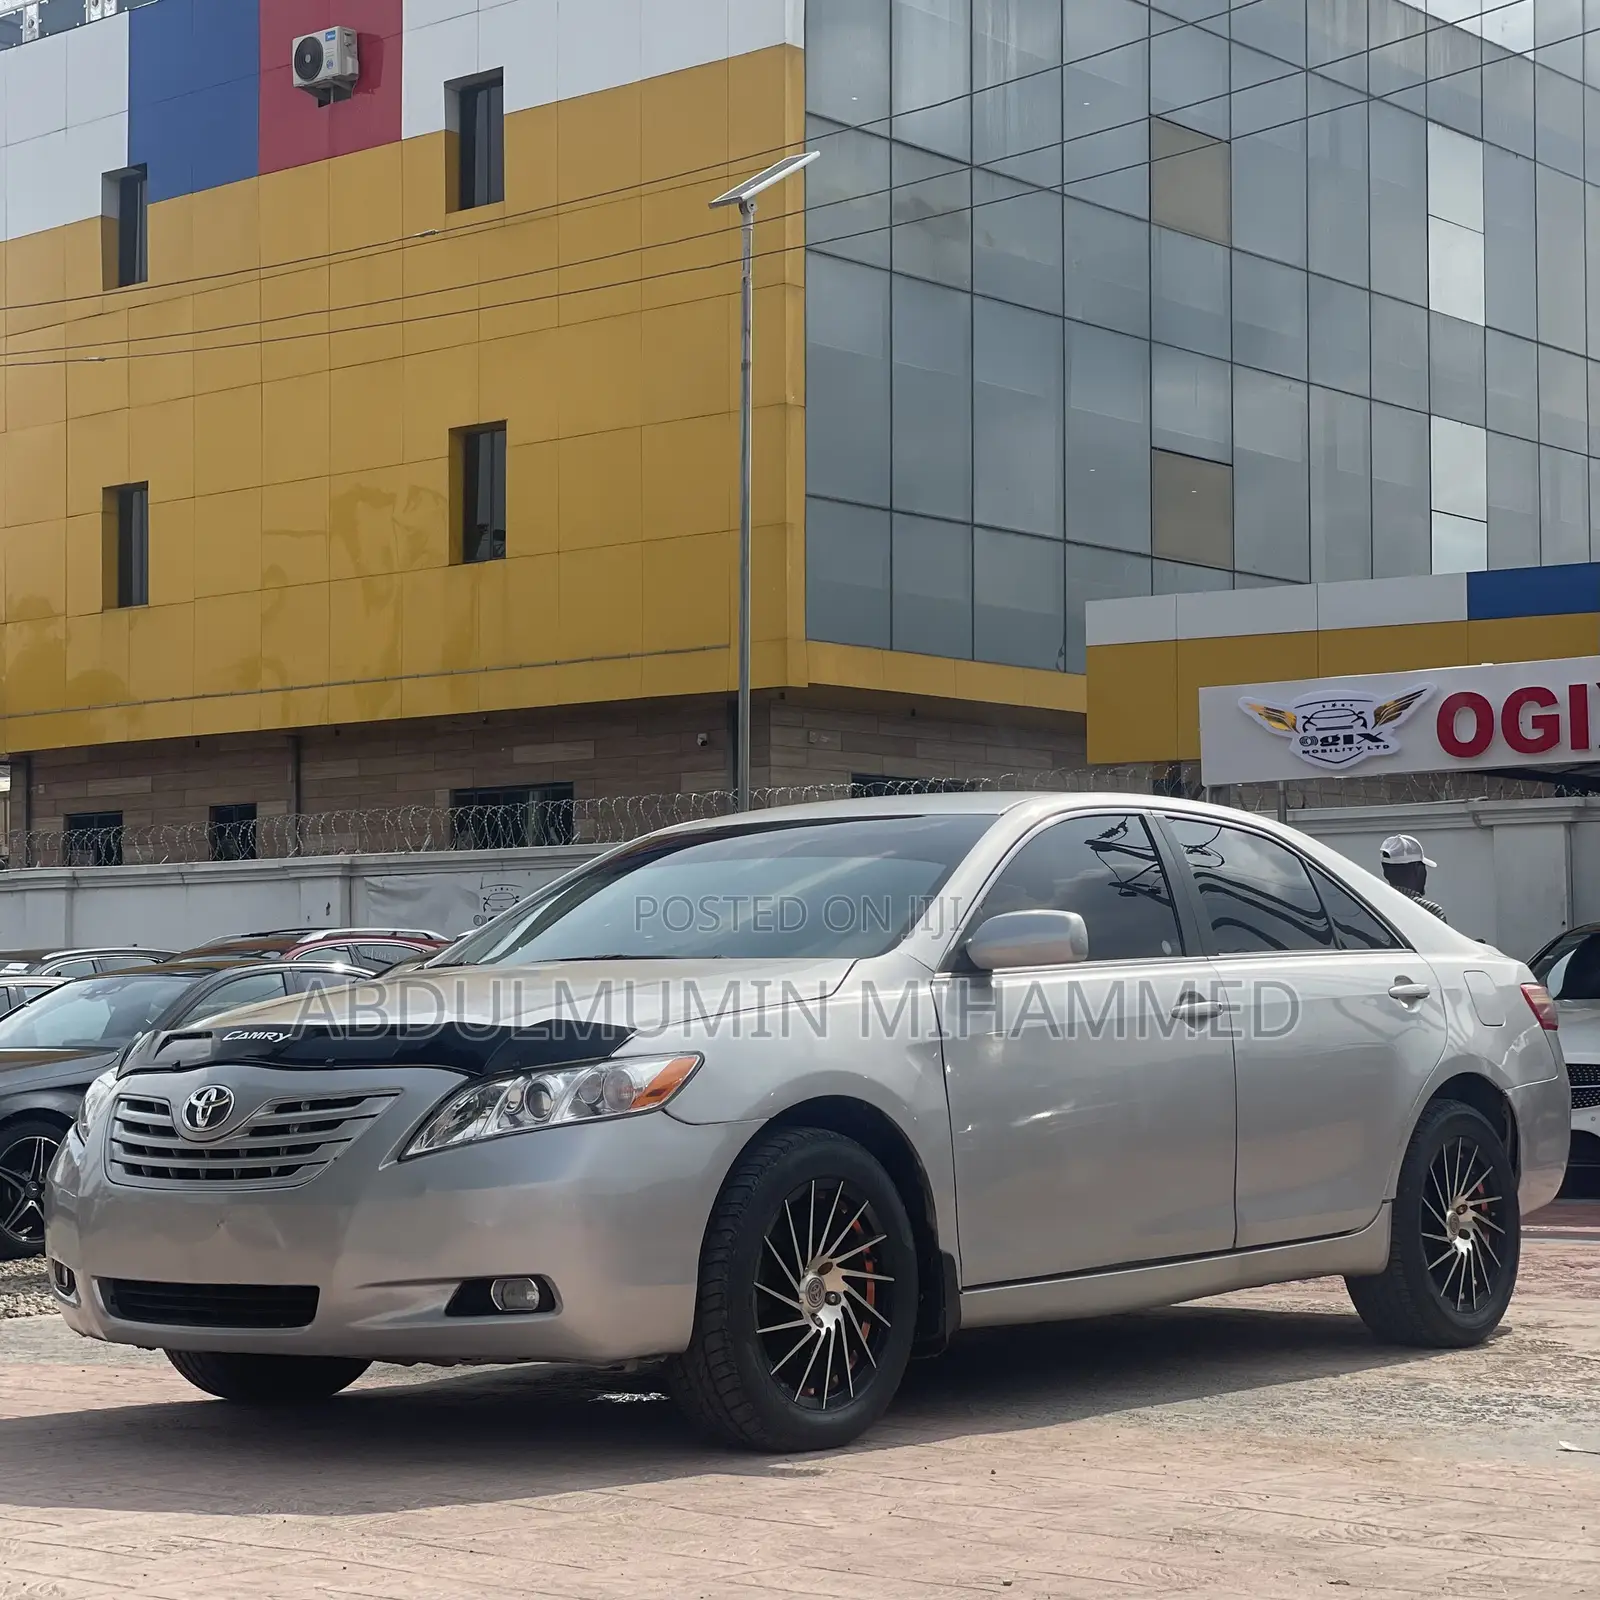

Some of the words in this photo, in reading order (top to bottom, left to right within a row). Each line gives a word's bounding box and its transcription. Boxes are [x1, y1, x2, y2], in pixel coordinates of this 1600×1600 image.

[1437, 683, 1600, 757] OGI
[1302, 746, 1362, 755] MOBILITY
[222, 1031, 292, 1043] CAMRY
